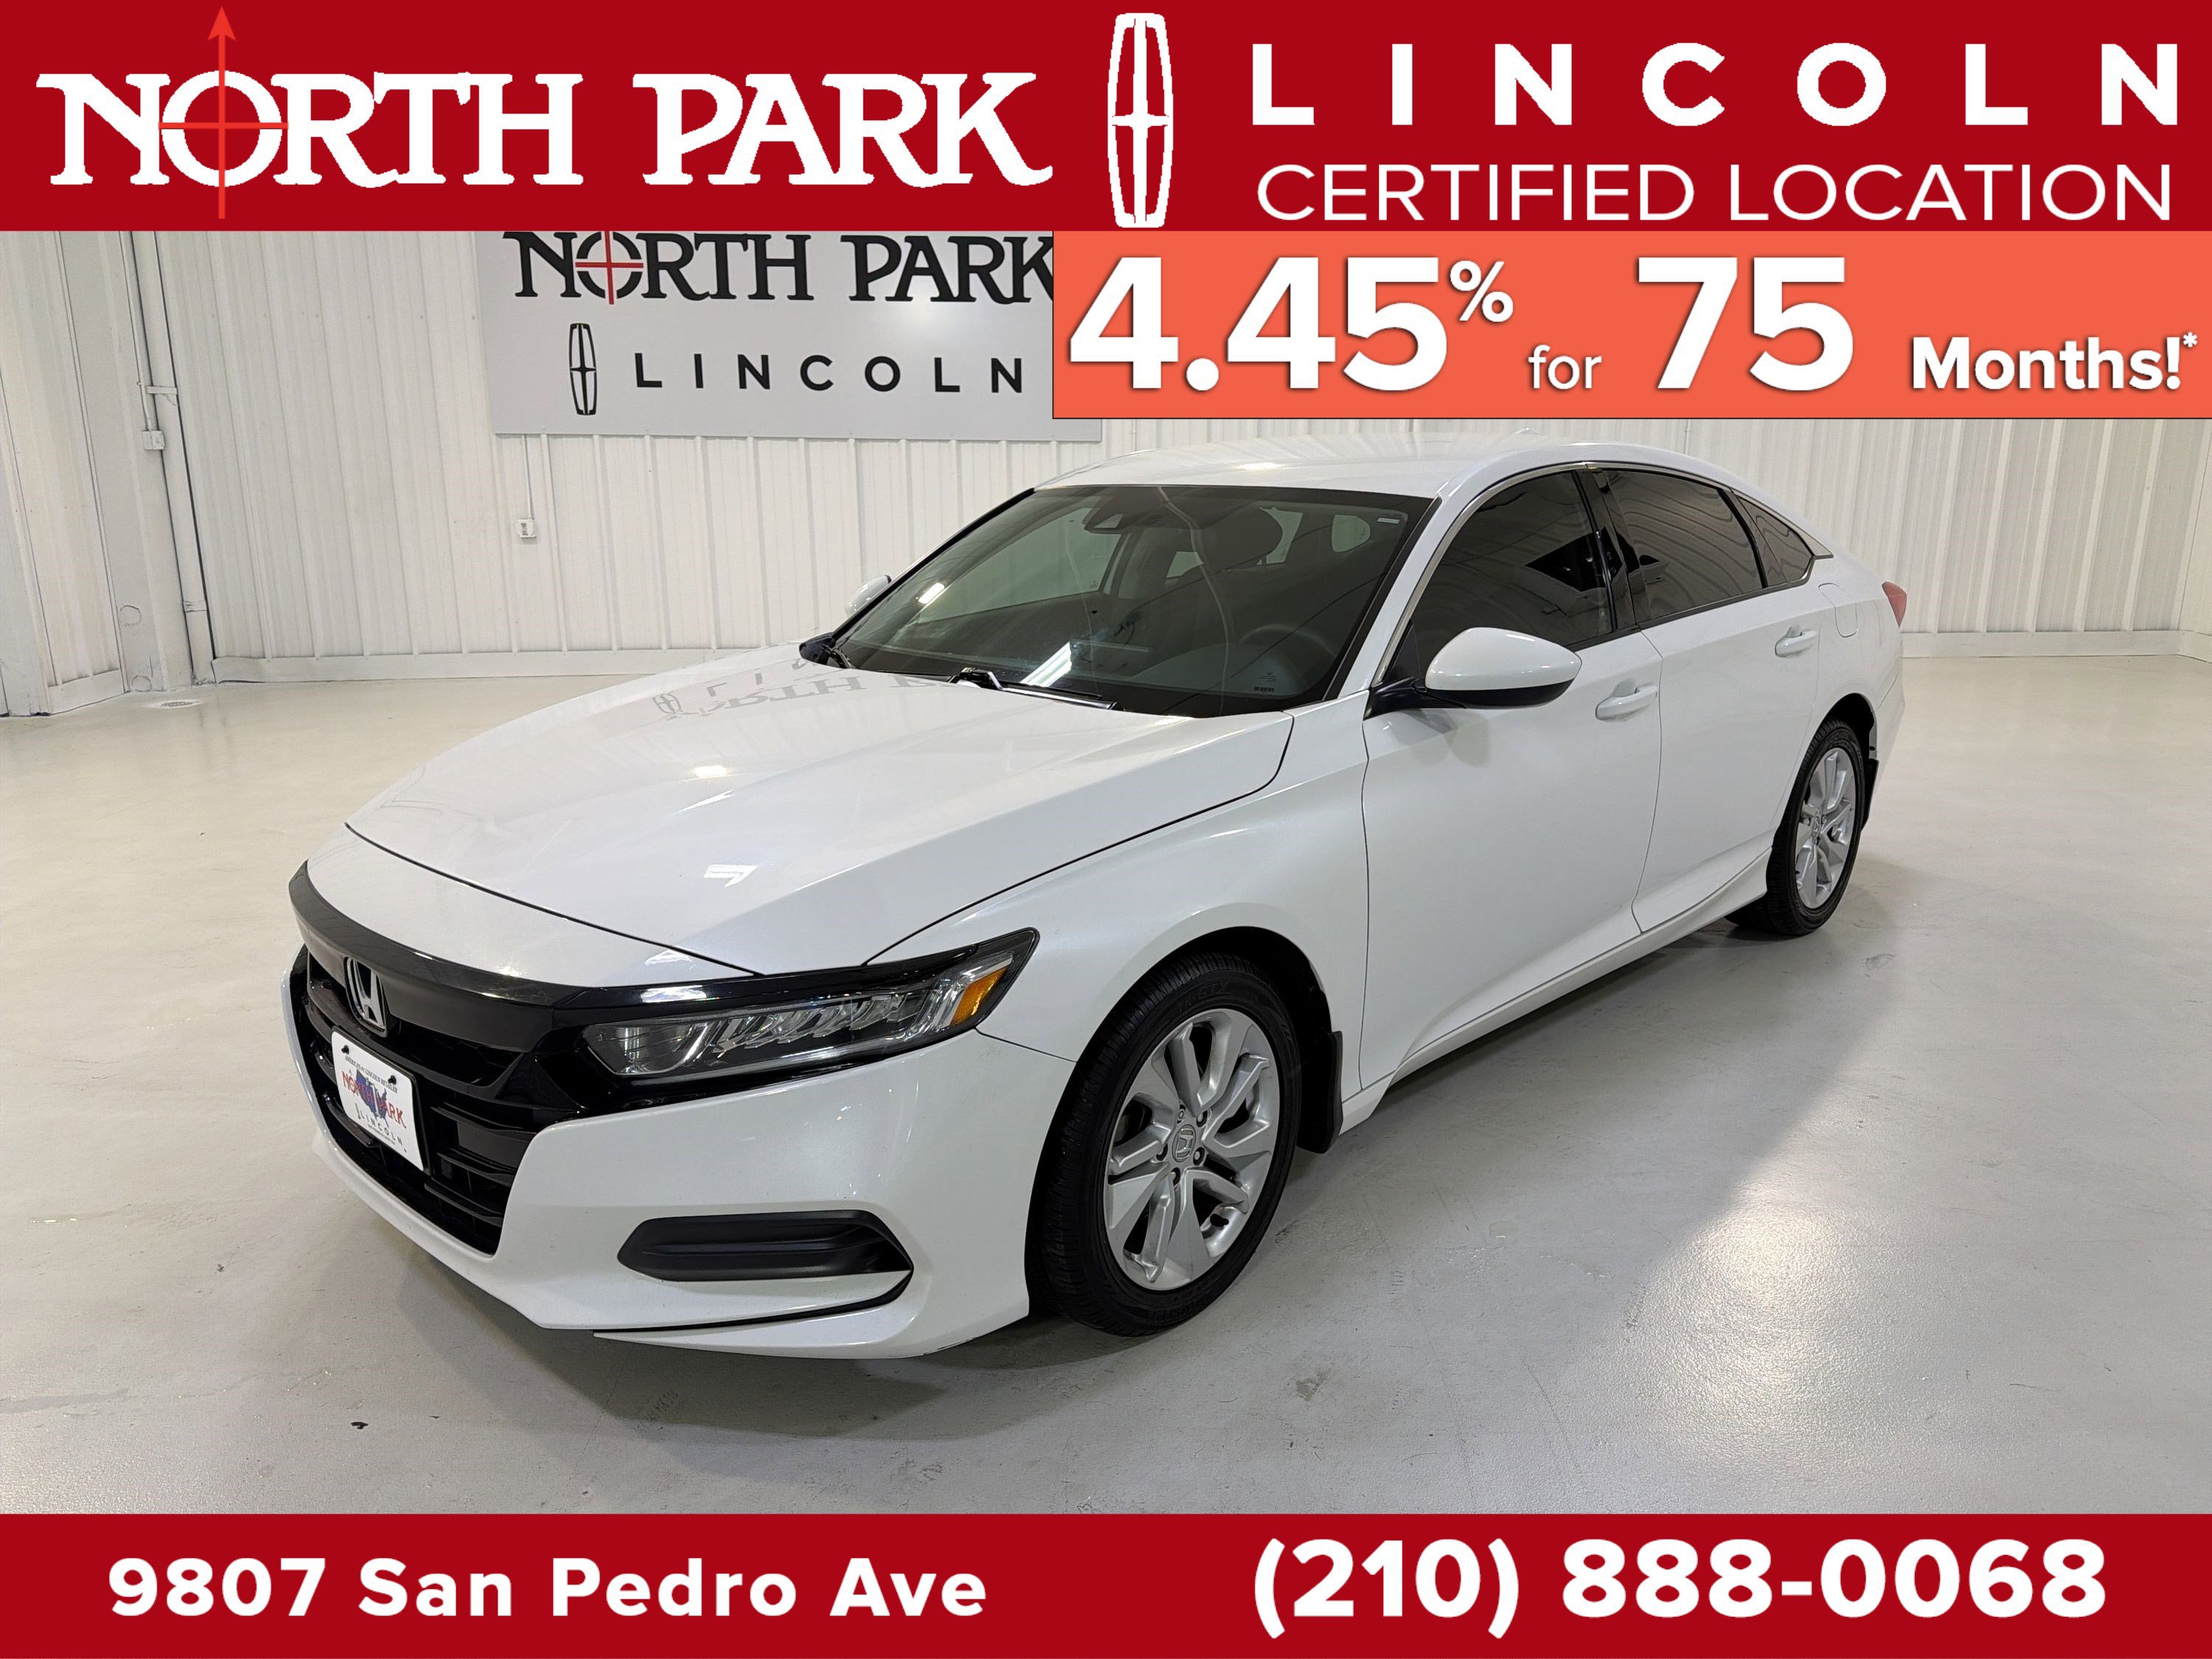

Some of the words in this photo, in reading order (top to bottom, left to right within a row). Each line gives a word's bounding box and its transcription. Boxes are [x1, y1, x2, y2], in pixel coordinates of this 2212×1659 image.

[503, 231, 814, 304] NORTH
[841, 235, 1053, 305] PARK
[634, 352, 1022, 394] LINCOLN
[341, 1071, 375, 1106] NORTH
[375, 1089, 406, 1128] PARK
[361, 1110, 403, 1145] LINCOLN
